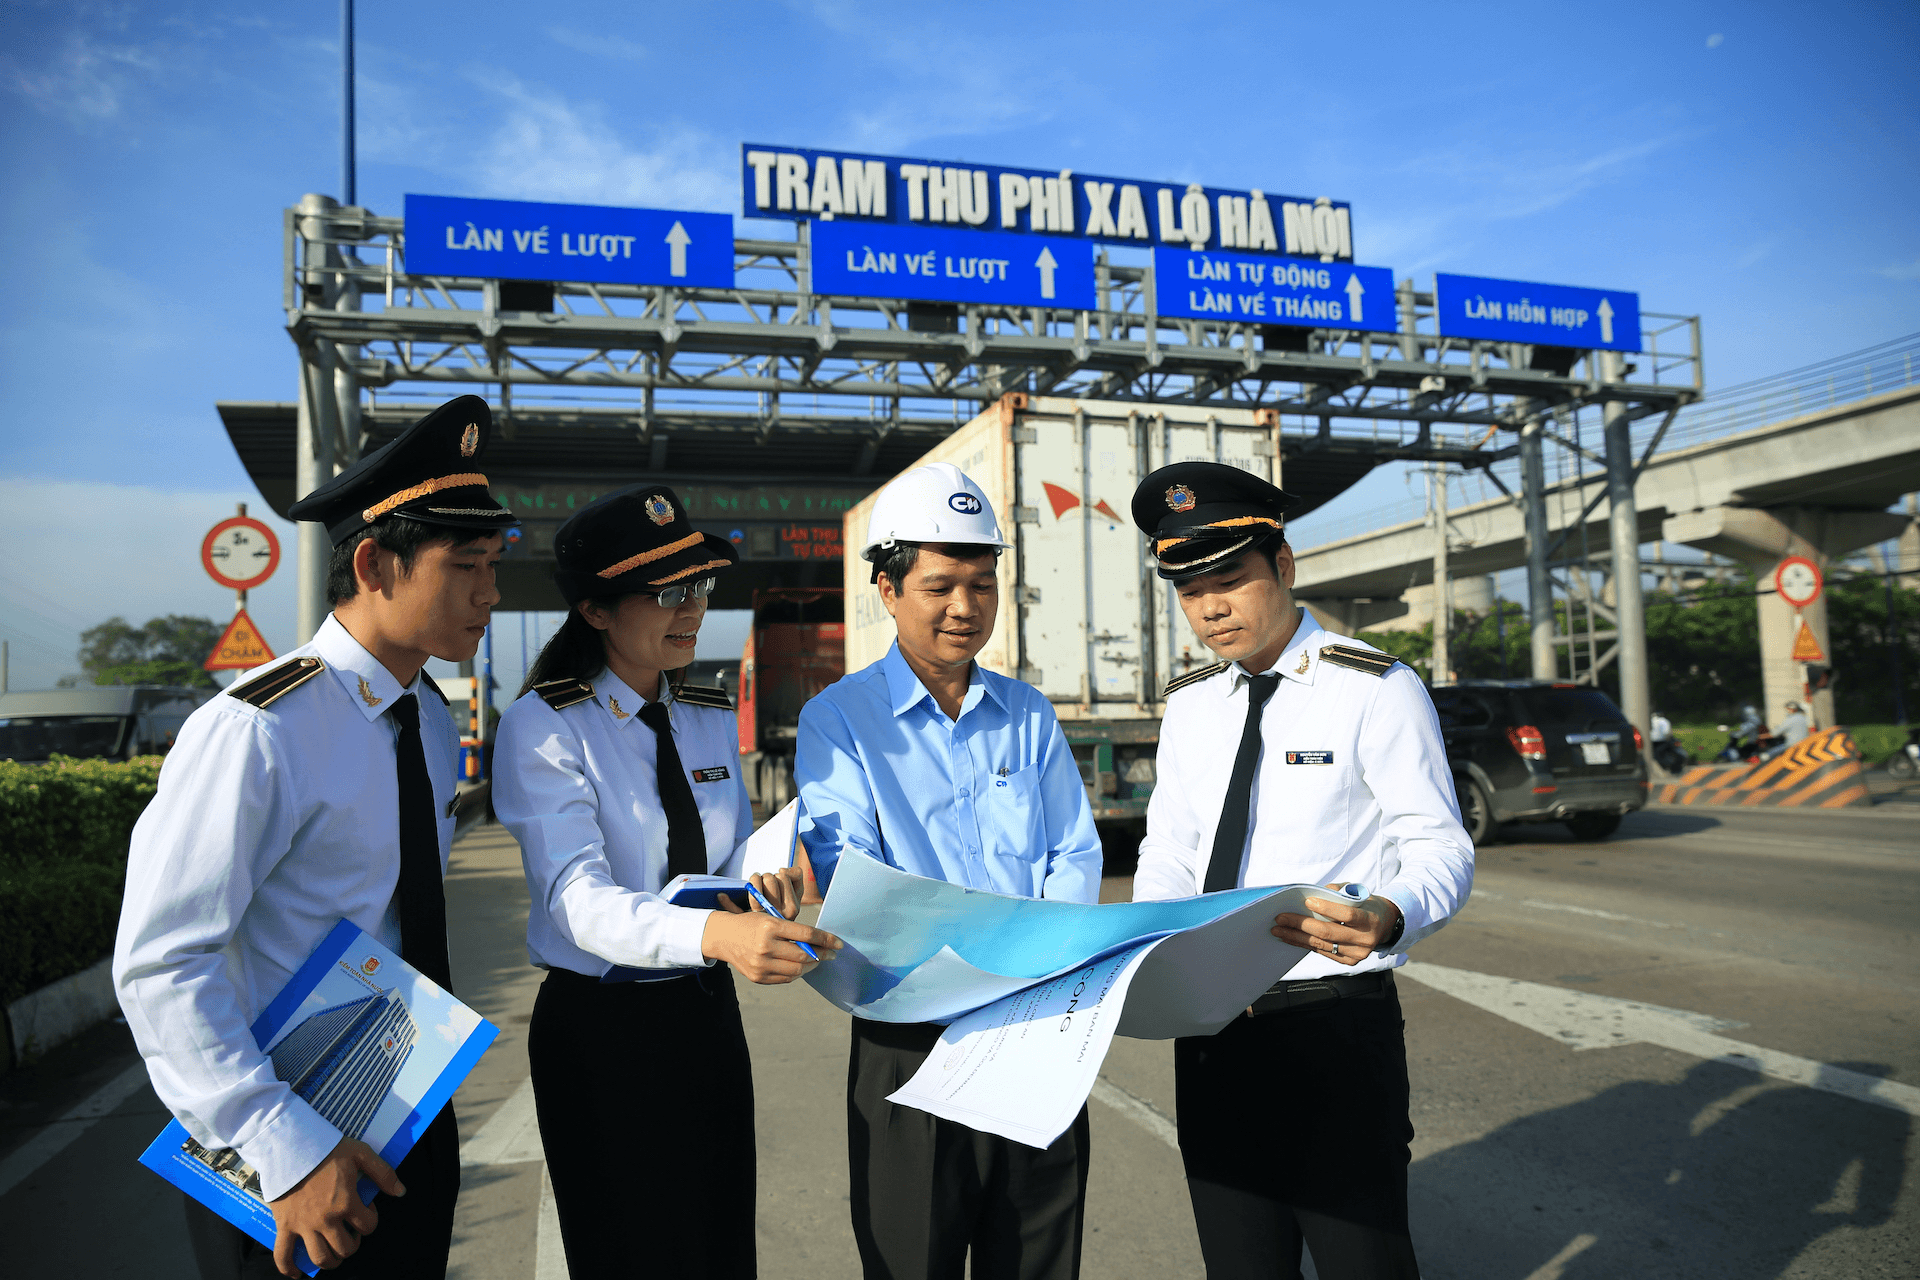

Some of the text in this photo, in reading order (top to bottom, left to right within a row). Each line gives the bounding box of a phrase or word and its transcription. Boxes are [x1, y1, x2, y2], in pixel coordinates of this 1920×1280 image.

[747, 151, 1352, 263] TRẠM THU PHÍ XA LỘ HÀ NỘI
[446, 221, 503, 251] LÀN
[562, 232, 636, 262] LƯỢT
[847, 246, 896, 274] LÀN
[945, 256, 1009, 284] LƯỢT
[1188, 255, 1330, 289] LÀN TỰ ĐỘNG
[1190, 287, 1233, 313] LÀN
[1273, 294, 1342, 321] THÁNG
[1465, 295, 1589, 331] LÀN HỖN HỢP
[1060, 967, 1094, 1032] CÔNG
[1077, 1041, 1089, 1063] MAI
